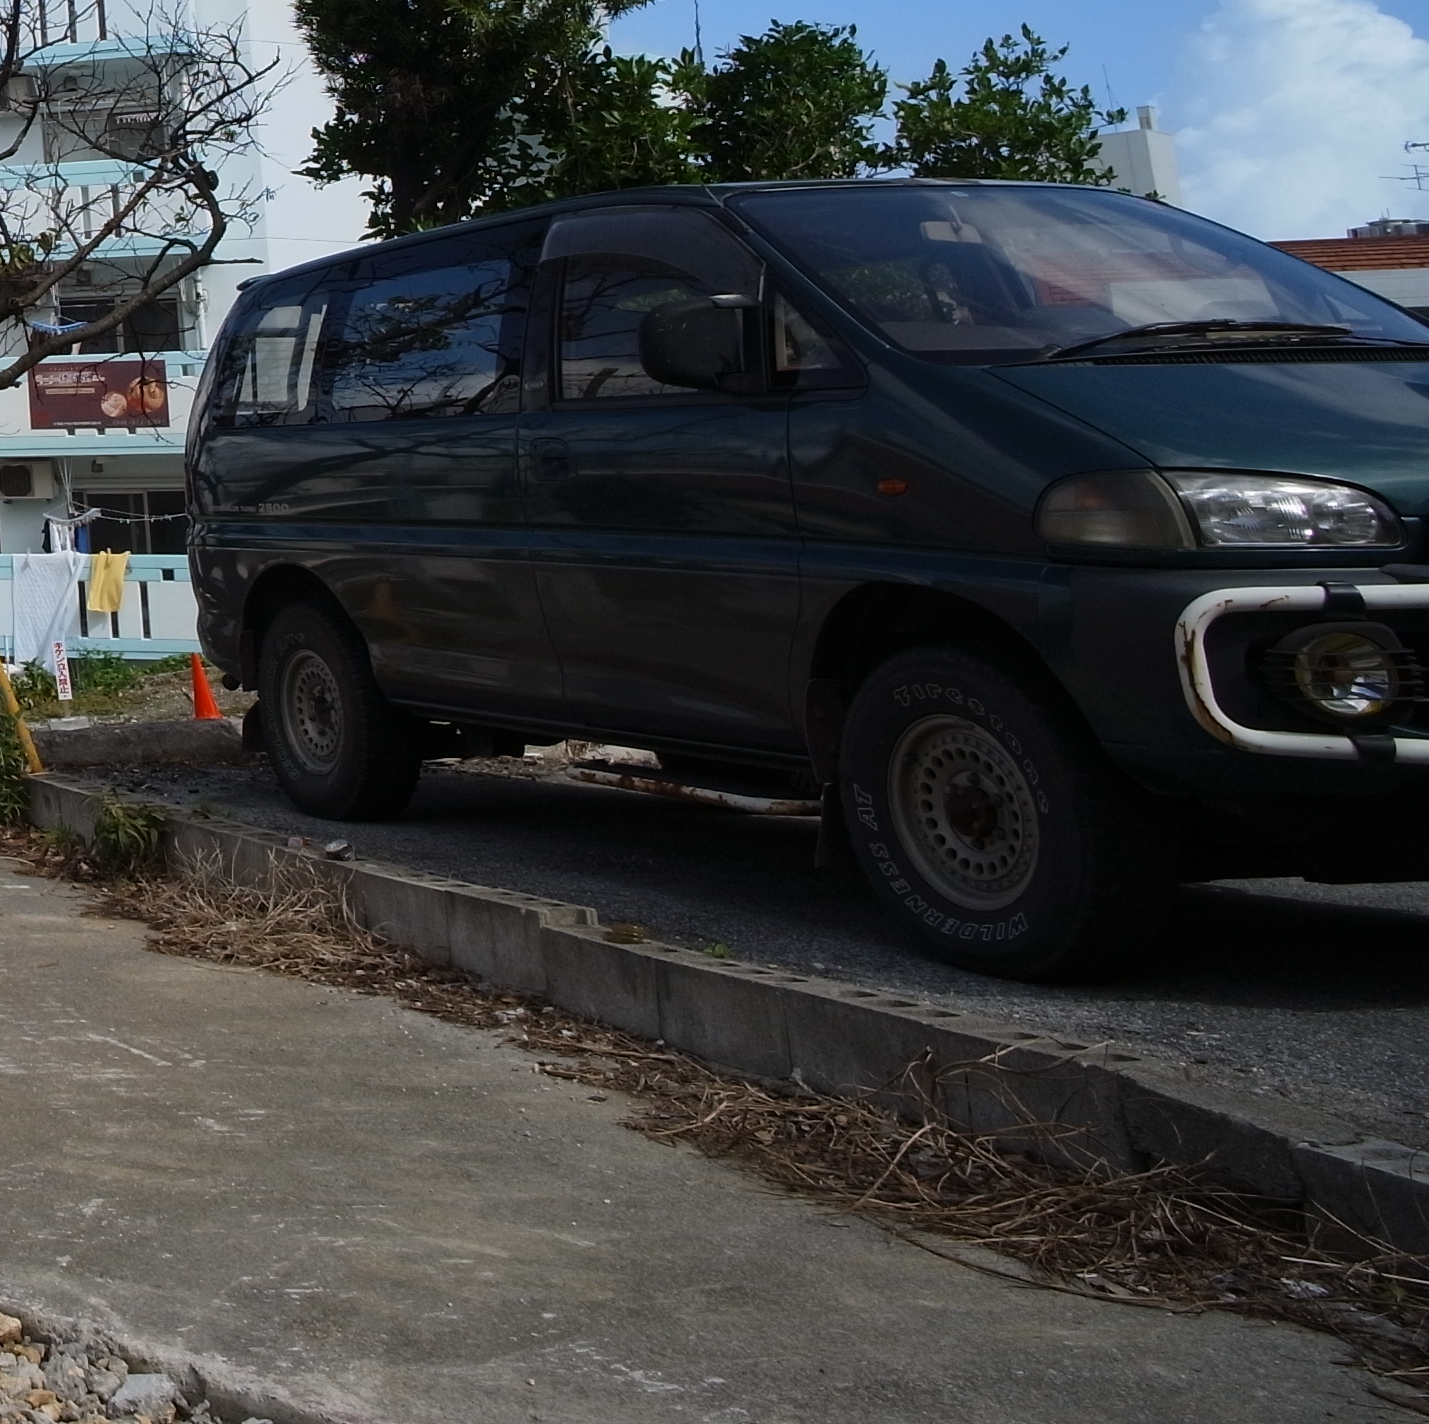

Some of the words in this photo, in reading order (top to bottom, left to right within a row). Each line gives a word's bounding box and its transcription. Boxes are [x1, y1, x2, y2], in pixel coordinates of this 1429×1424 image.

[258, 502, 290, 512] 2800
[893, 683, 1050, 814] Firestone
[853, 783, 879, 831] AT
[869, 842, 1029, 941] WILDERNESS
